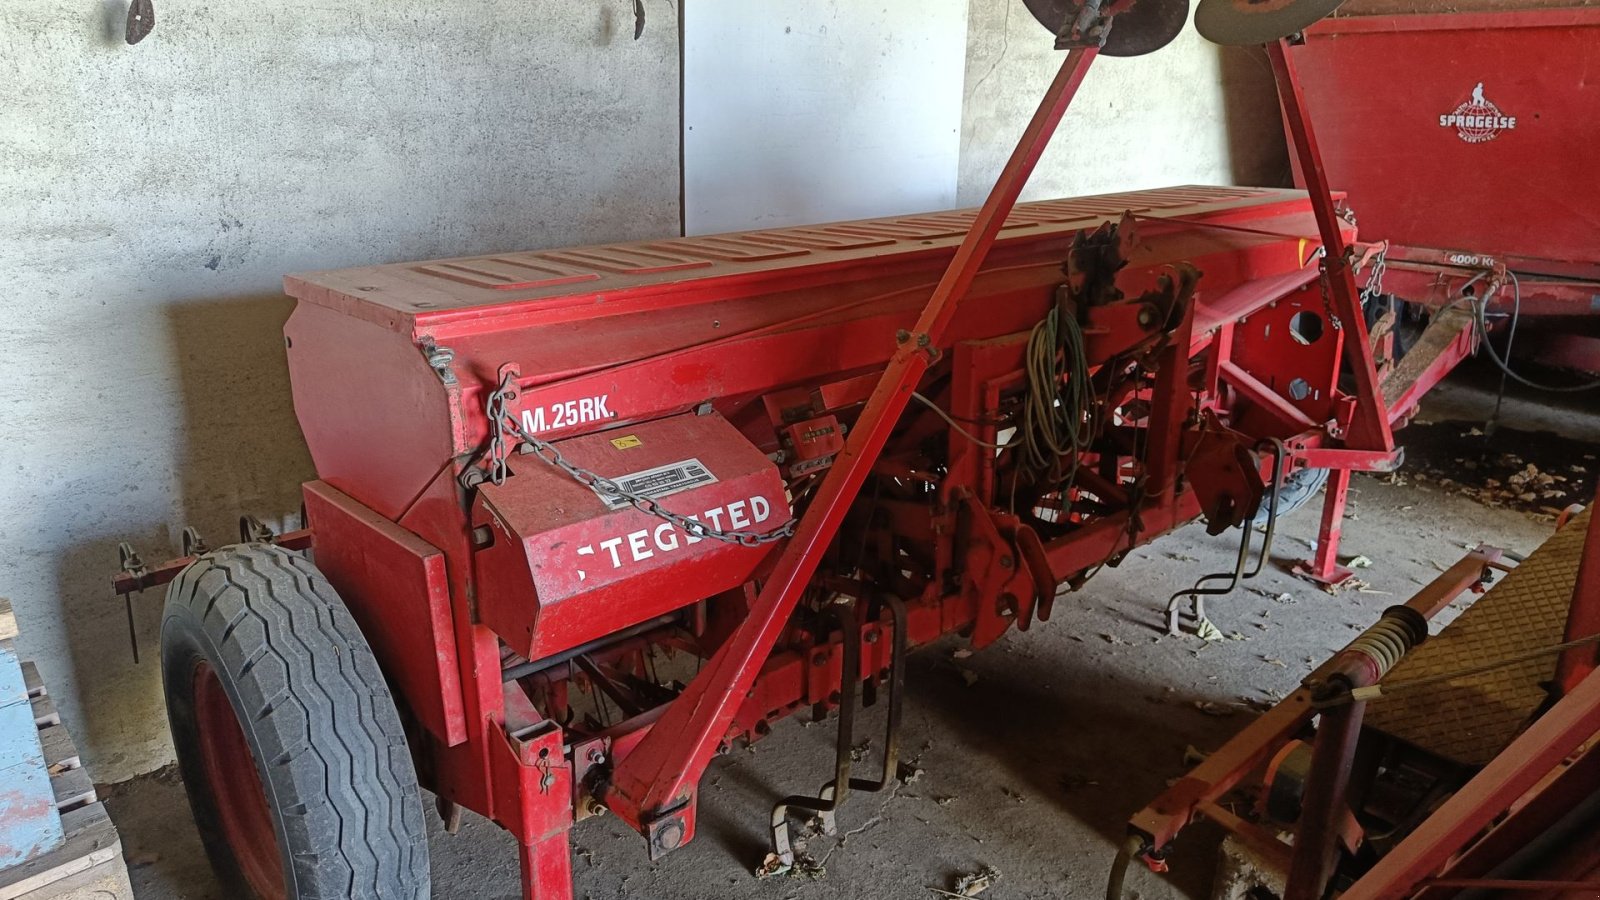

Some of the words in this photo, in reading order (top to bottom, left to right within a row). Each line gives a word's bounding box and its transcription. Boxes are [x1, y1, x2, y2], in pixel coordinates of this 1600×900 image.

[1439, 114, 1517, 129] SPRAGELSE
[1449, 254, 1479, 265] 4000
[521, 394, 614, 434] M.25RK.
